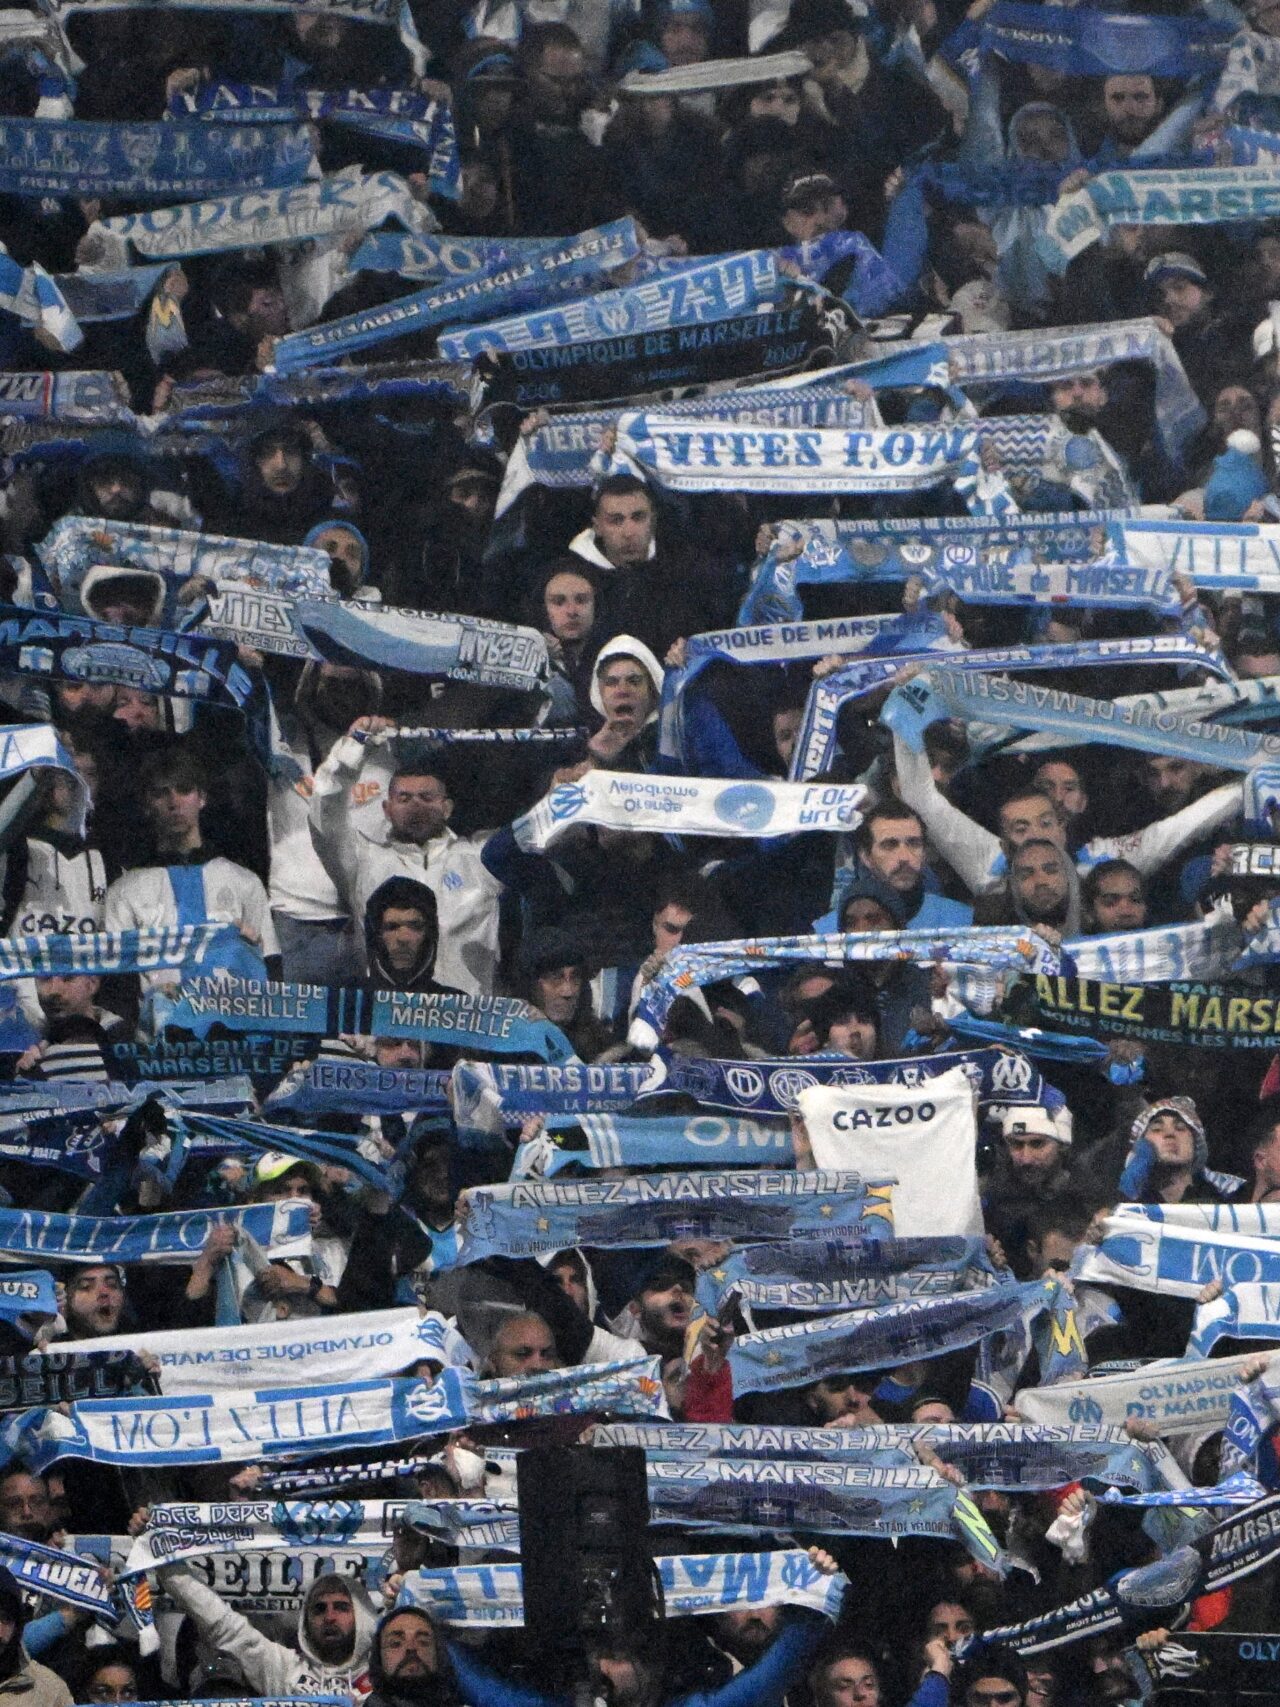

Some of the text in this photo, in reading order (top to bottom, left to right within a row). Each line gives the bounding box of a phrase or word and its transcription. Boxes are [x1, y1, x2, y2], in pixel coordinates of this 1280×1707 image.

[511, 313, 801, 370] OLYMPIQUE DE MARSEILLE
[779, 624, 809, 646] DE
[188, 995, 309, 1021] MARSEILLE
[1034, 972, 1145, 1023] ALLEZ
[390, 1006, 515, 1040] MARSEILLE
[1190, 1031, 1227, 1048] LES
[138, 1057, 284, 1077] MARSEILLE
[499, 1064, 582, 1093] FIERS
[682, 1115, 785, 1147] OM
[831, 1101, 936, 1132] CAZOO
[511, 1170, 868, 1209] ALLEZ MARSEILLE
[721, 1461, 950, 1490] MARSEILLE
